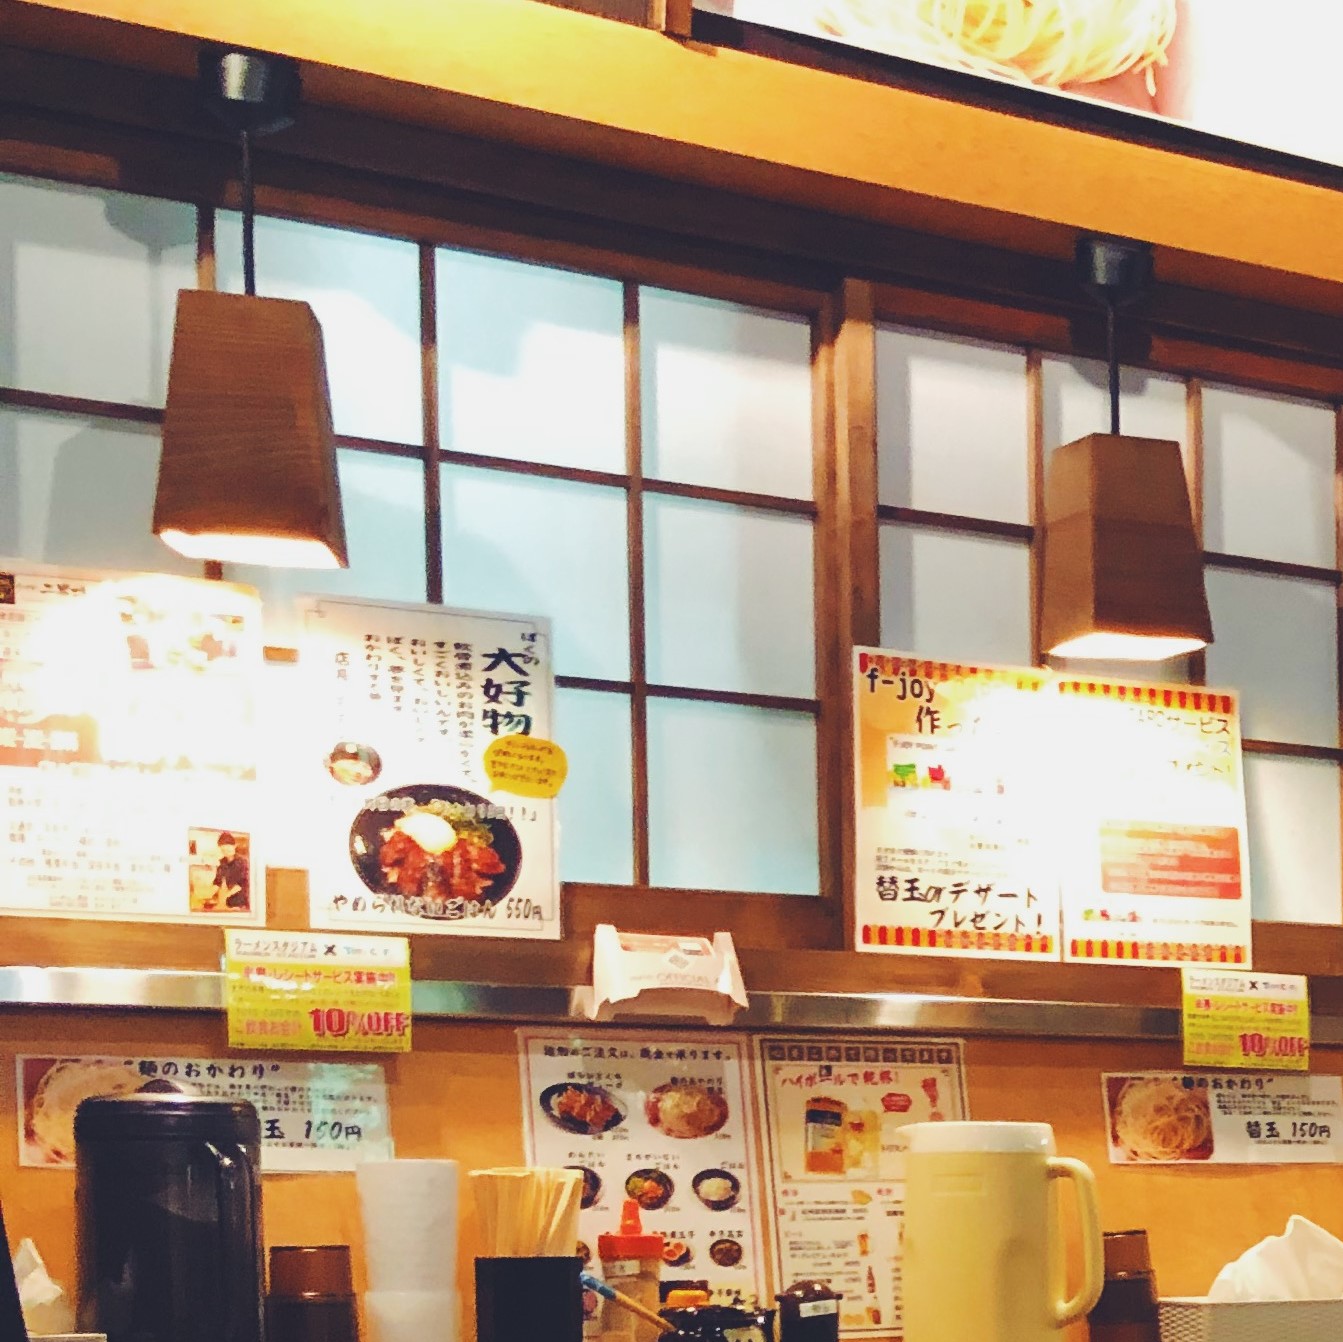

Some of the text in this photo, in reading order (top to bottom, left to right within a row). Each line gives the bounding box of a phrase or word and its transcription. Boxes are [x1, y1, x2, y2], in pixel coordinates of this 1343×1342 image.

[481, 647, 532, 736] 大好物
[264, 1118, 285, 1139] 玉
[1246, 1120, 1332, 1139] 替玉 150円
